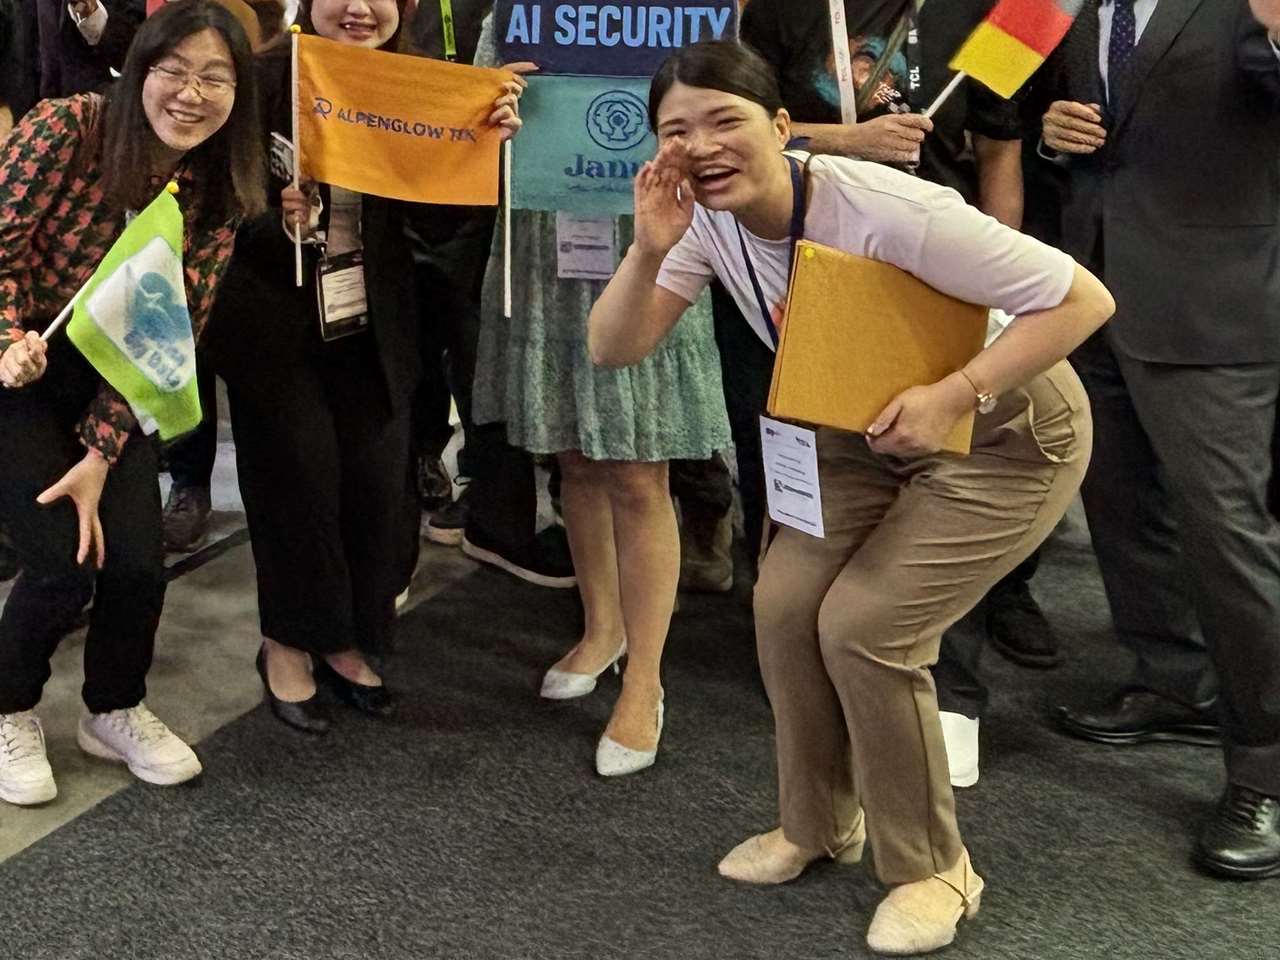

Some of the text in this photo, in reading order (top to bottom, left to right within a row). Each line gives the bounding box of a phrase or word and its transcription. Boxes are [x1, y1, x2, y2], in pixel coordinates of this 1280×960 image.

[505, 4, 731, 48] AI SECURITY
[909, 65, 921, 90] TCL
[336, 107, 444, 139] ALPENGLOW
